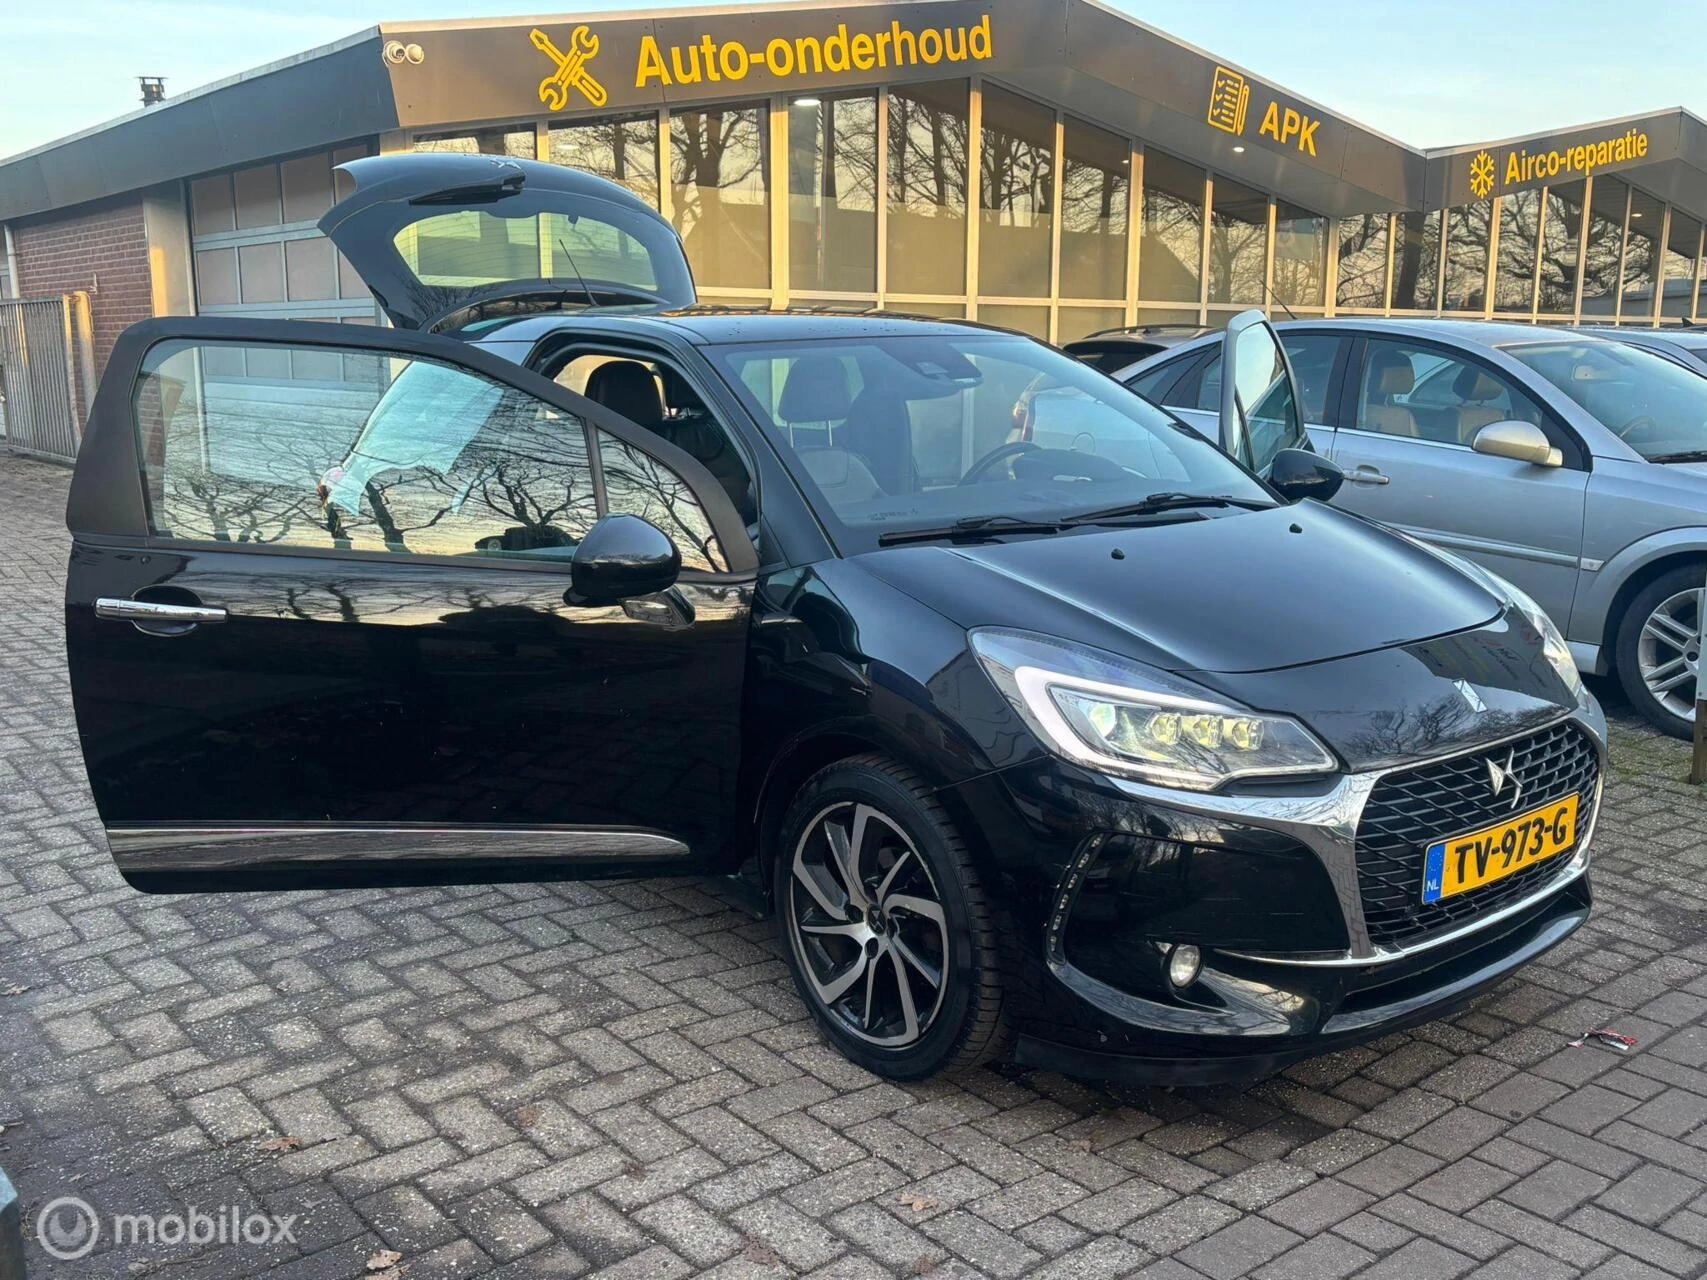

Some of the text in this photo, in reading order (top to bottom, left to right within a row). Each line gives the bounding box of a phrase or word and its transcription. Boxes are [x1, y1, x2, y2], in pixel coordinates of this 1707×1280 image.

[635, 15, 993, 88] Auto-onderhoud
[1259, 101, 1321, 157] APK
[1504, 128, 1649, 186] Airco-reparatie
[1455, 806, 1568, 884] TV-973-G
[1426, 880, 1440, 892] NL
